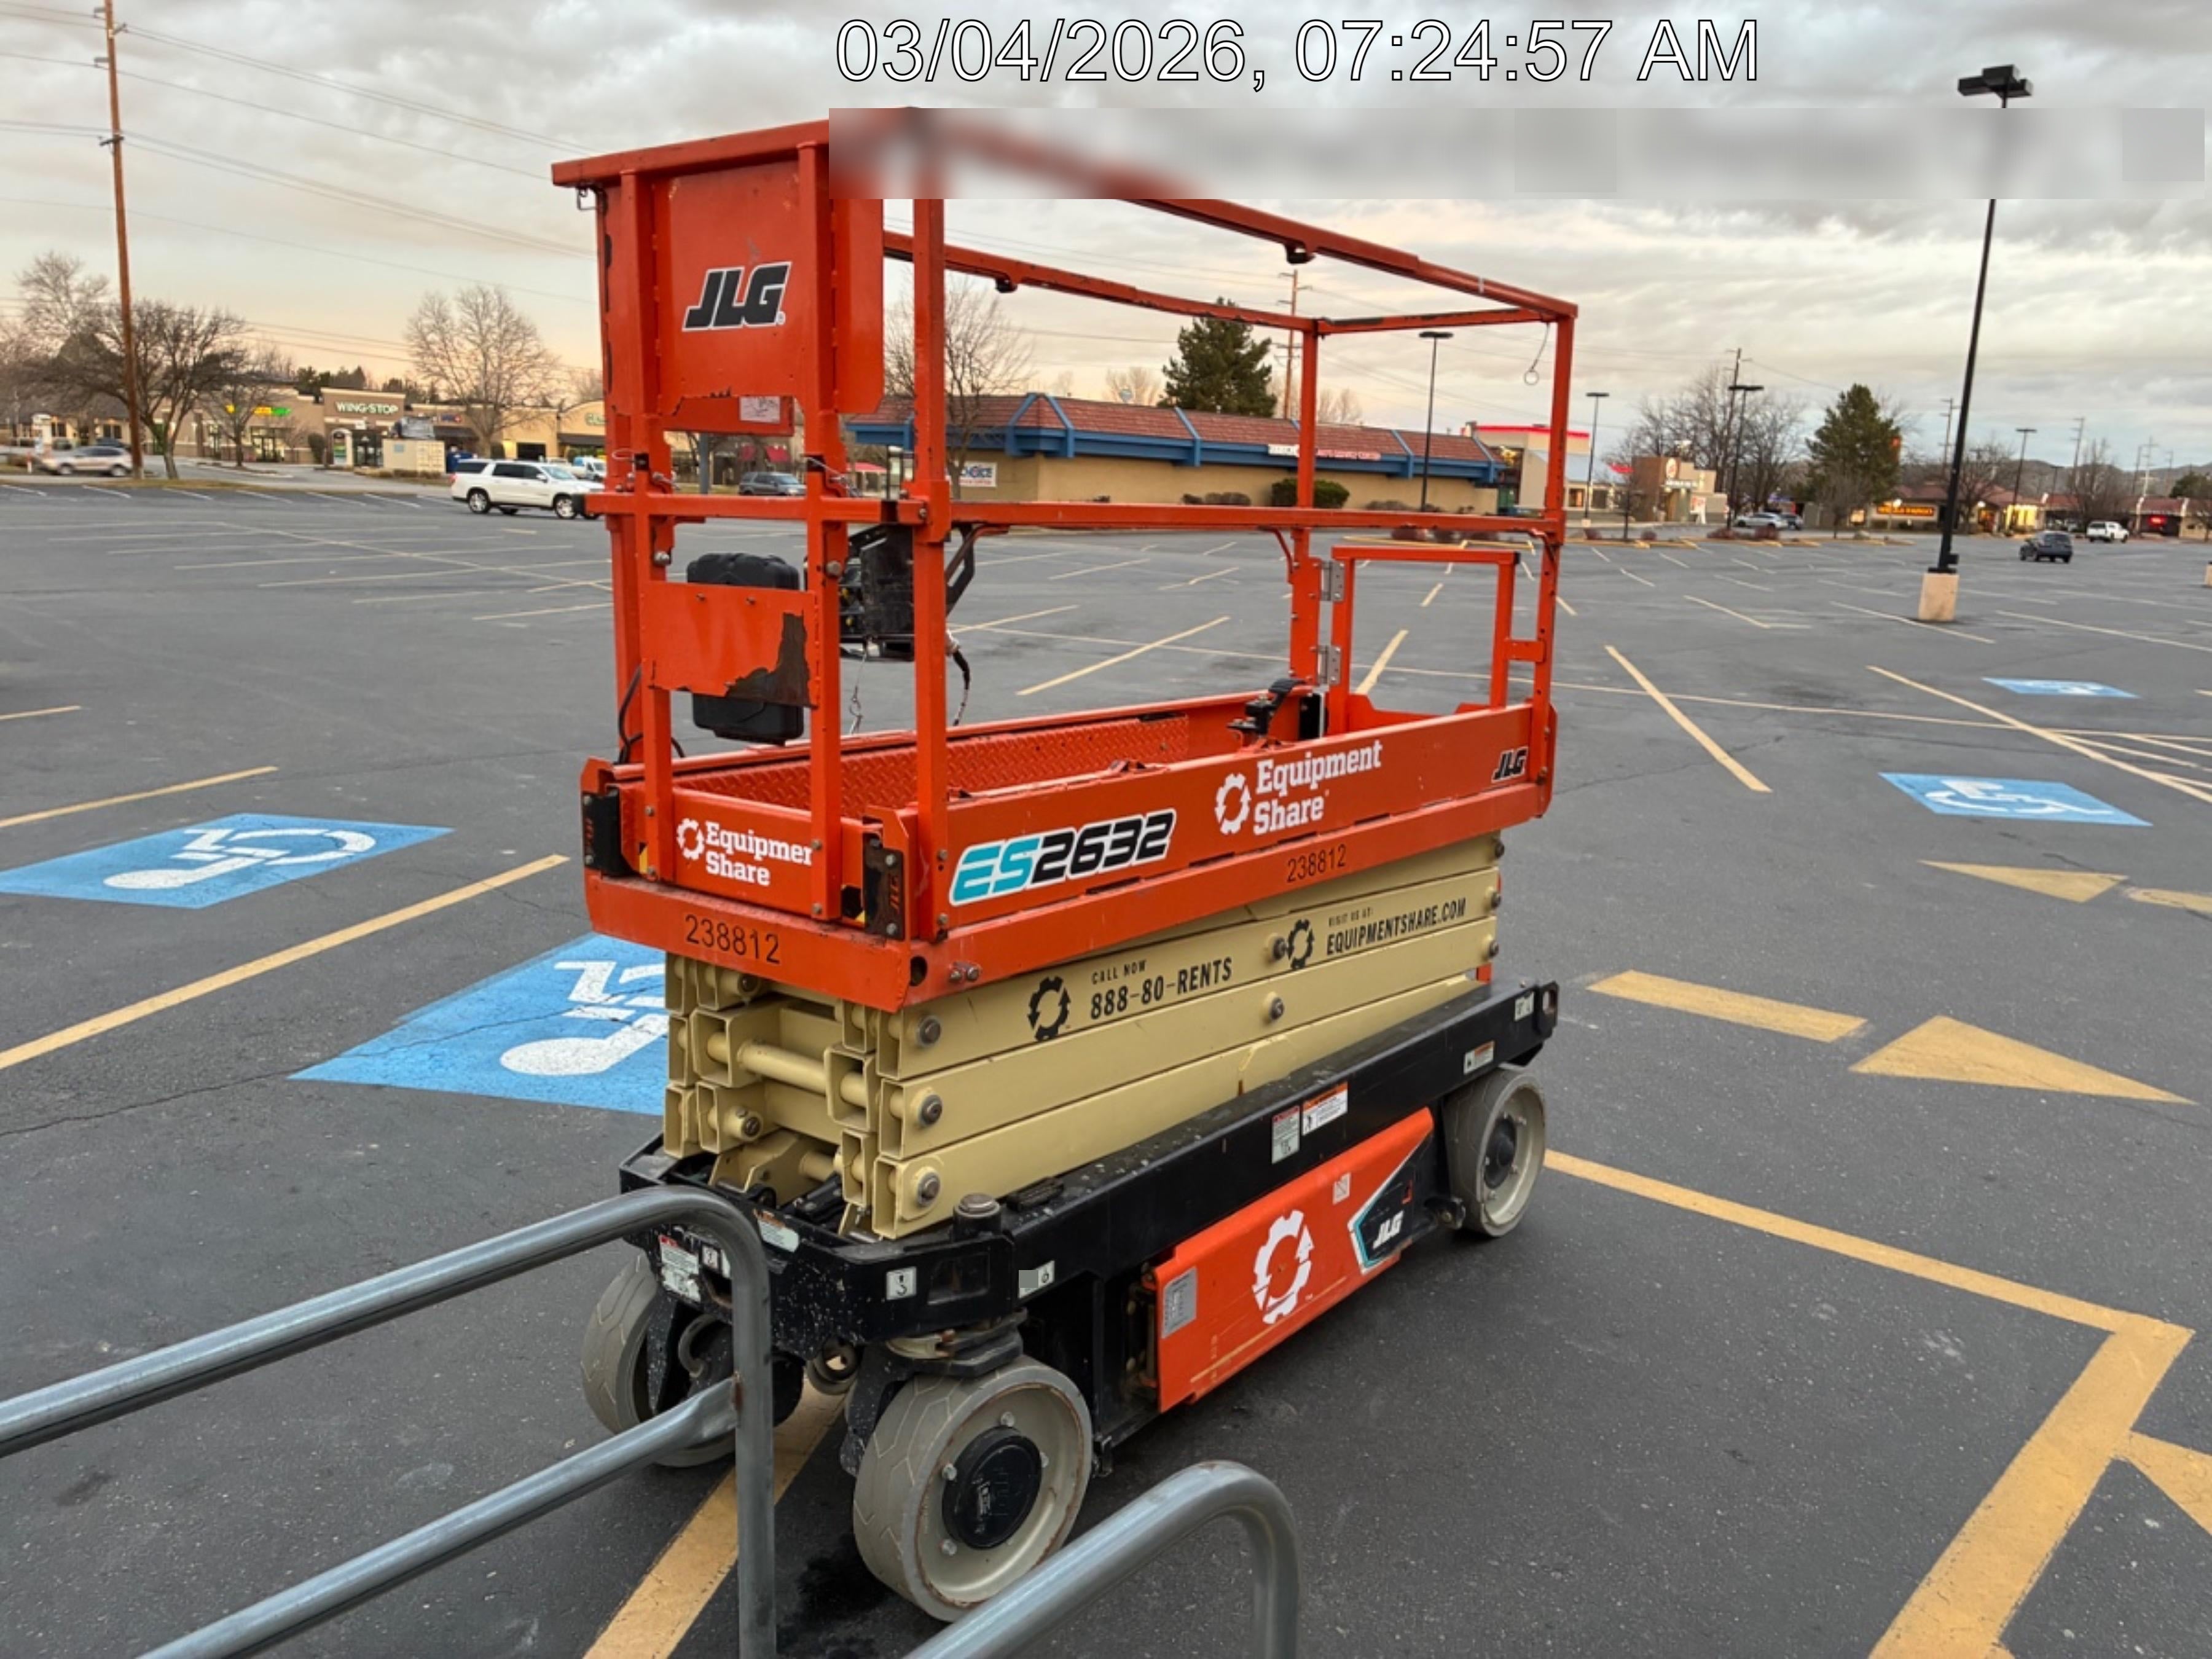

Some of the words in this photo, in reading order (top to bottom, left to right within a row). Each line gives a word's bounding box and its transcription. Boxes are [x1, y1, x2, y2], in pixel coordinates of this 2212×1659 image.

[682, 261, 791, 332] JLG
[1255, 739, 1382, 797] Equipment
[1491, 746, 1529, 783] JLG
[1253, 794, 1324, 835] Share
[706, 850, 770, 886] Share
[949, 808, 1176, 906] ES2632
[1287, 843, 1346, 883] 238812
[685, 914, 780, 965] 238812
[1327, 897, 1466, 955] EQUIPMENTSHARE.COM
[1091, 967, 1118, 984] CALL
[1123, 959, 1147, 976] NOW
[1091, 957, 1232, 1020] 888-80-RENTS
[1373, 1210, 1404, 1250] JLG
